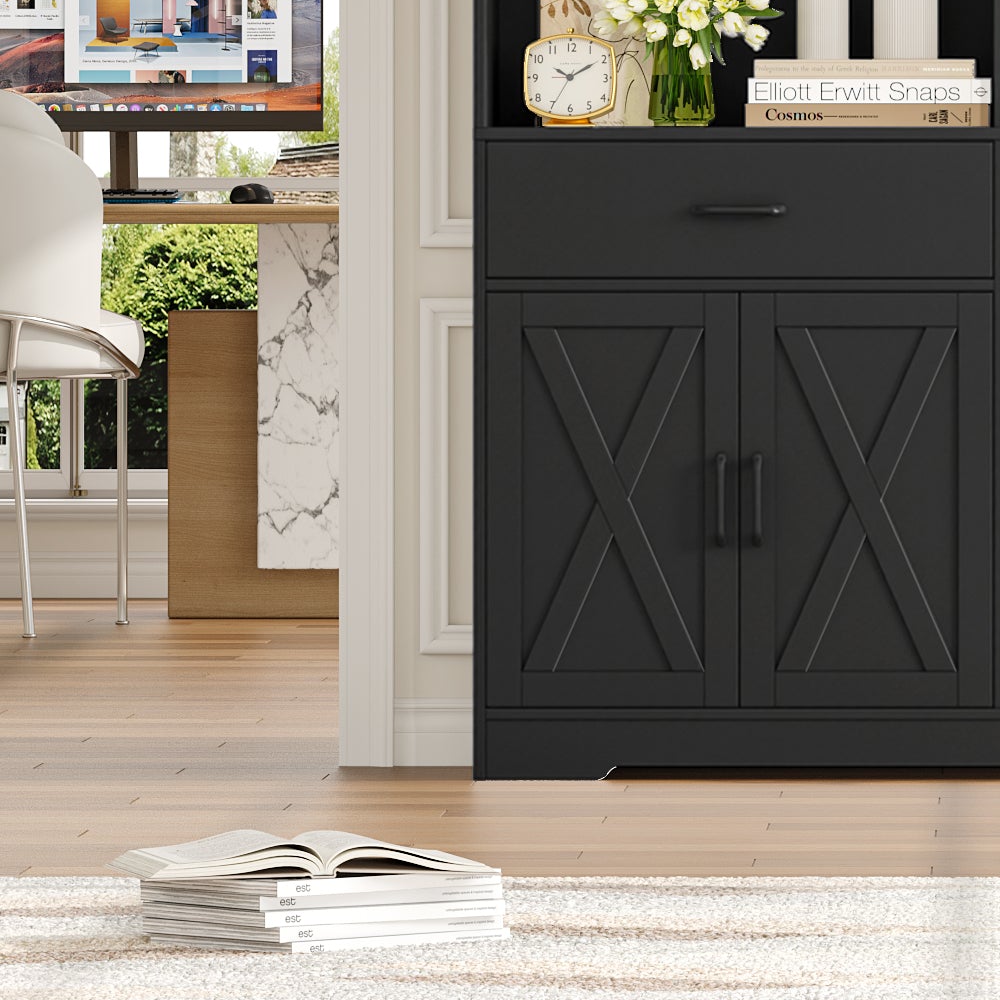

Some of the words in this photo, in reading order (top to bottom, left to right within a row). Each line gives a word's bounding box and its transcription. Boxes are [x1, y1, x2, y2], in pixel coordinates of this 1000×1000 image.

[548, 45, 556, 55] 11
[567, 42, 577, 52] 12
[589, 45, 592, 55] 1
[534, 54, 544, 64] 10
[601, 54, 607, 64] 2
[532, 73, 538, 83] 9
[602, 73, 608, 83] 3
[535, 93, 541, 102] 8
[754, 81, 812, 101] Elliott
[820, 81, 881, 101] Erwitt
[889, 81, 961, 104] Snaps
[600, 94, 606, 103] 4
[567, 103, 573, 113] 6
[586, 100, 592, 110] 5
[765, 108, 824, 121] Cosmos
[295, 884, 311, 892] est
[280, 897, 296, 906] est
[285, 914, 301, 923] est
[298, 930, 314, 938] est
[310, 944, 325, 952] est
